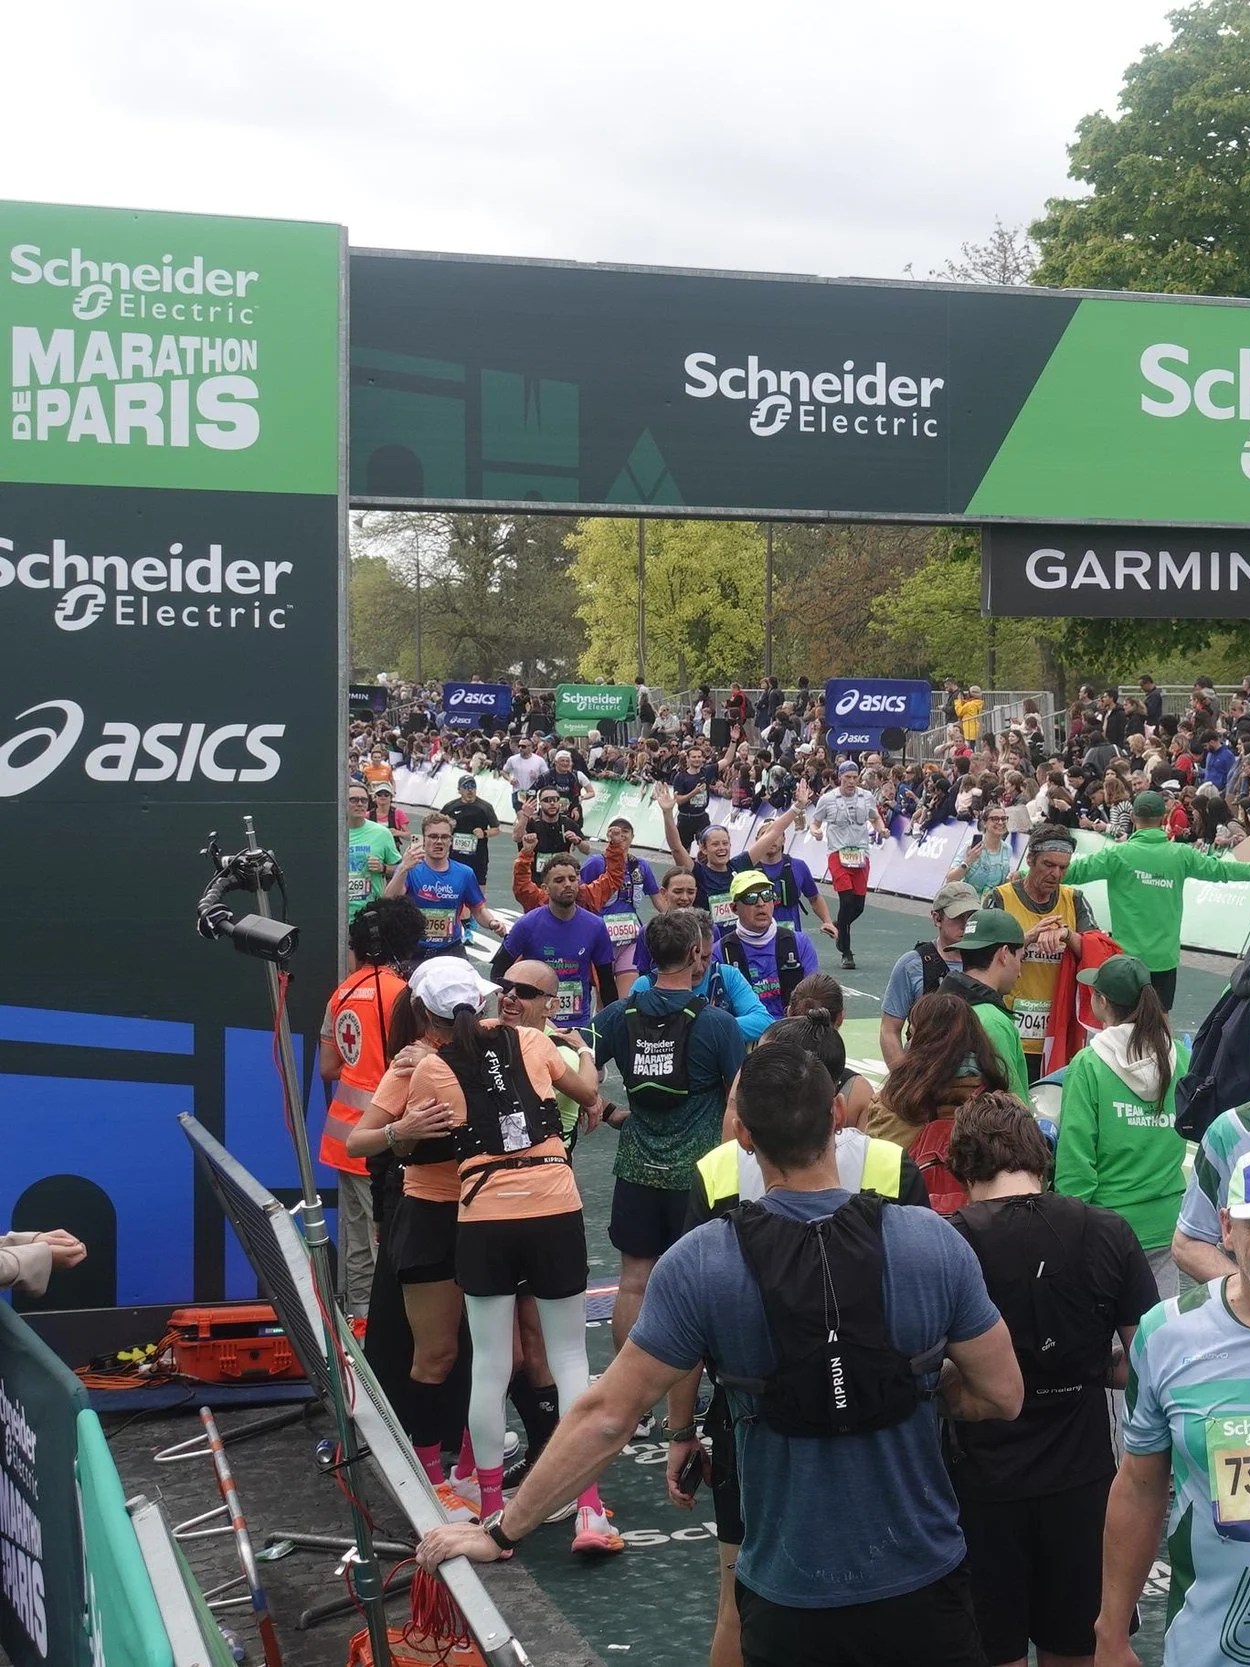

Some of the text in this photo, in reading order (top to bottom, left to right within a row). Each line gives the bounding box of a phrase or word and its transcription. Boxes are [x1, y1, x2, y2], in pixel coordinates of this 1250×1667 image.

[10, 244, 258, 298] Schneider
[119, 293, 254, 325] Electric
[12, 326, 257, 386] MARATHON
[684, 352, 944, 407] Schneider
[12, 375, 260, 450] DE PARIS
[799, 406, 938, 437] Electric
[0, 537, 293, 595] Schneider
[116, 596, 287, 629] Electric
[464, 693, 496, 706] asics
[562, 692, 623, 705] Schneider
[588, 703, 621, 711] Electric
[859, 695, 907, 712] asics
[85, 722, 286, 781] asics
[636, 1039, 675, 1050] Schneider
[638, 1059, 674, 1076] PARIS
[1112, 1101, 1145, 1118] TEAM
[830, 1357, 847, 1409] KIPRUN
[6, 1540, 48, 1659] PARIS
